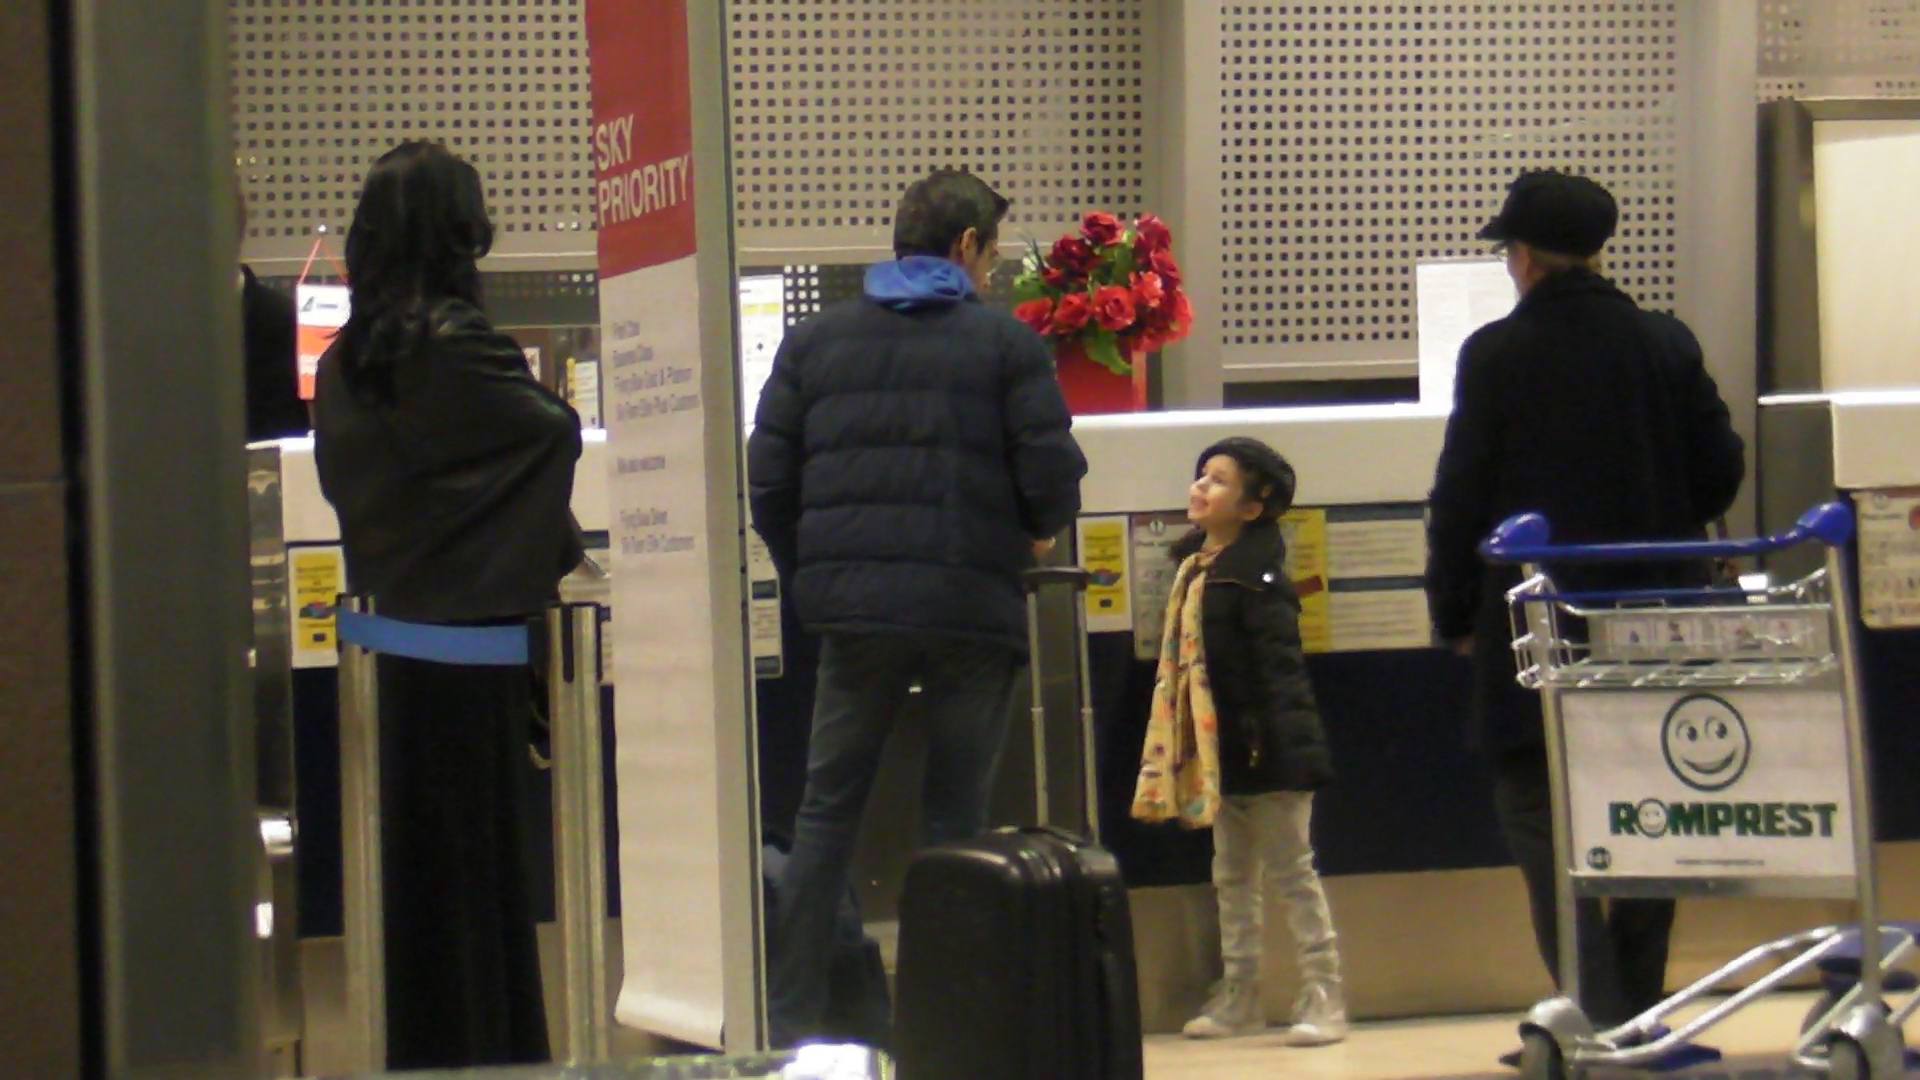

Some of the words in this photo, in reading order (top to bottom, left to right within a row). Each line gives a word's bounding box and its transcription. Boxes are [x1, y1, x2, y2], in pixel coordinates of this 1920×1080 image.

[596, 114, 634, 172] SKY
[598, 154, 688, 227] PRIORITY
[1608, 798, 1837, 838] ROMPREST
